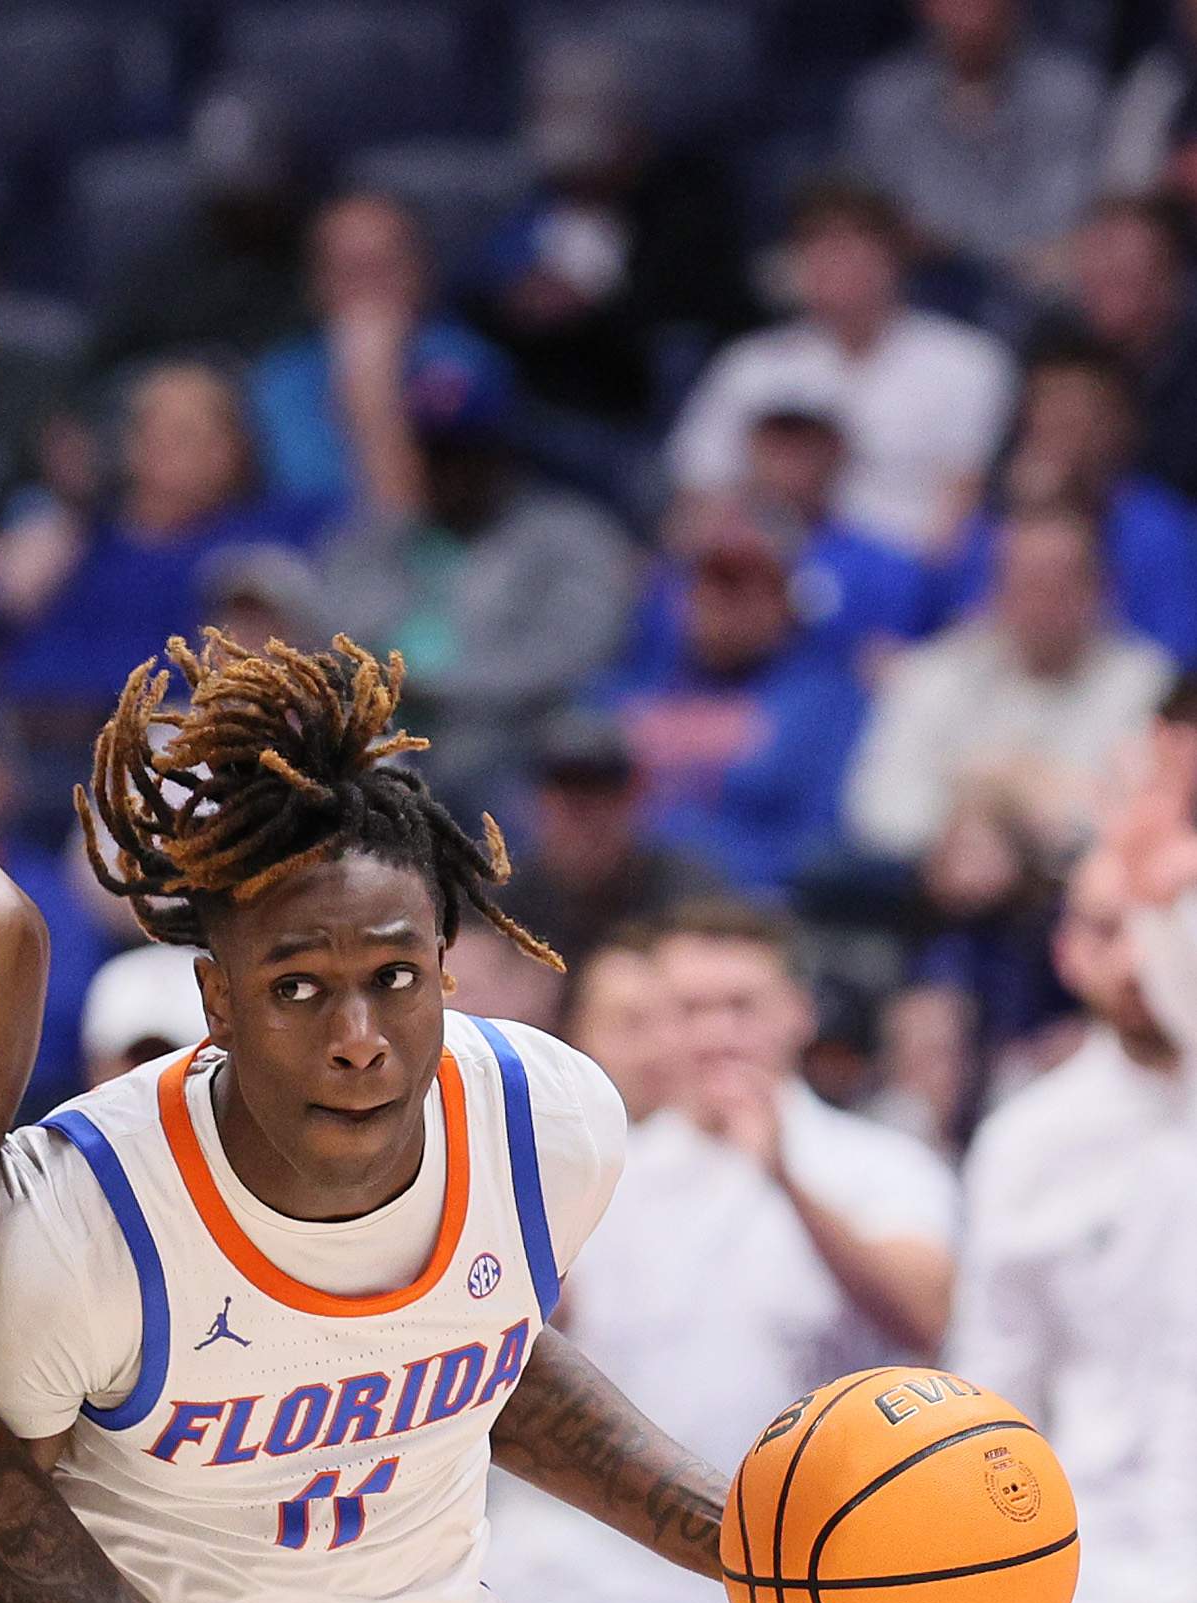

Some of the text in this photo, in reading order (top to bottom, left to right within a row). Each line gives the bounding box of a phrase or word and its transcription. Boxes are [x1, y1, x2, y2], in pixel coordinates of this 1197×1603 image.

[469, 1255, 500, 1297] SEC
[141, 1317, 530, 1467] FLORIDA
[274, 1455, 401, 1551] 11
